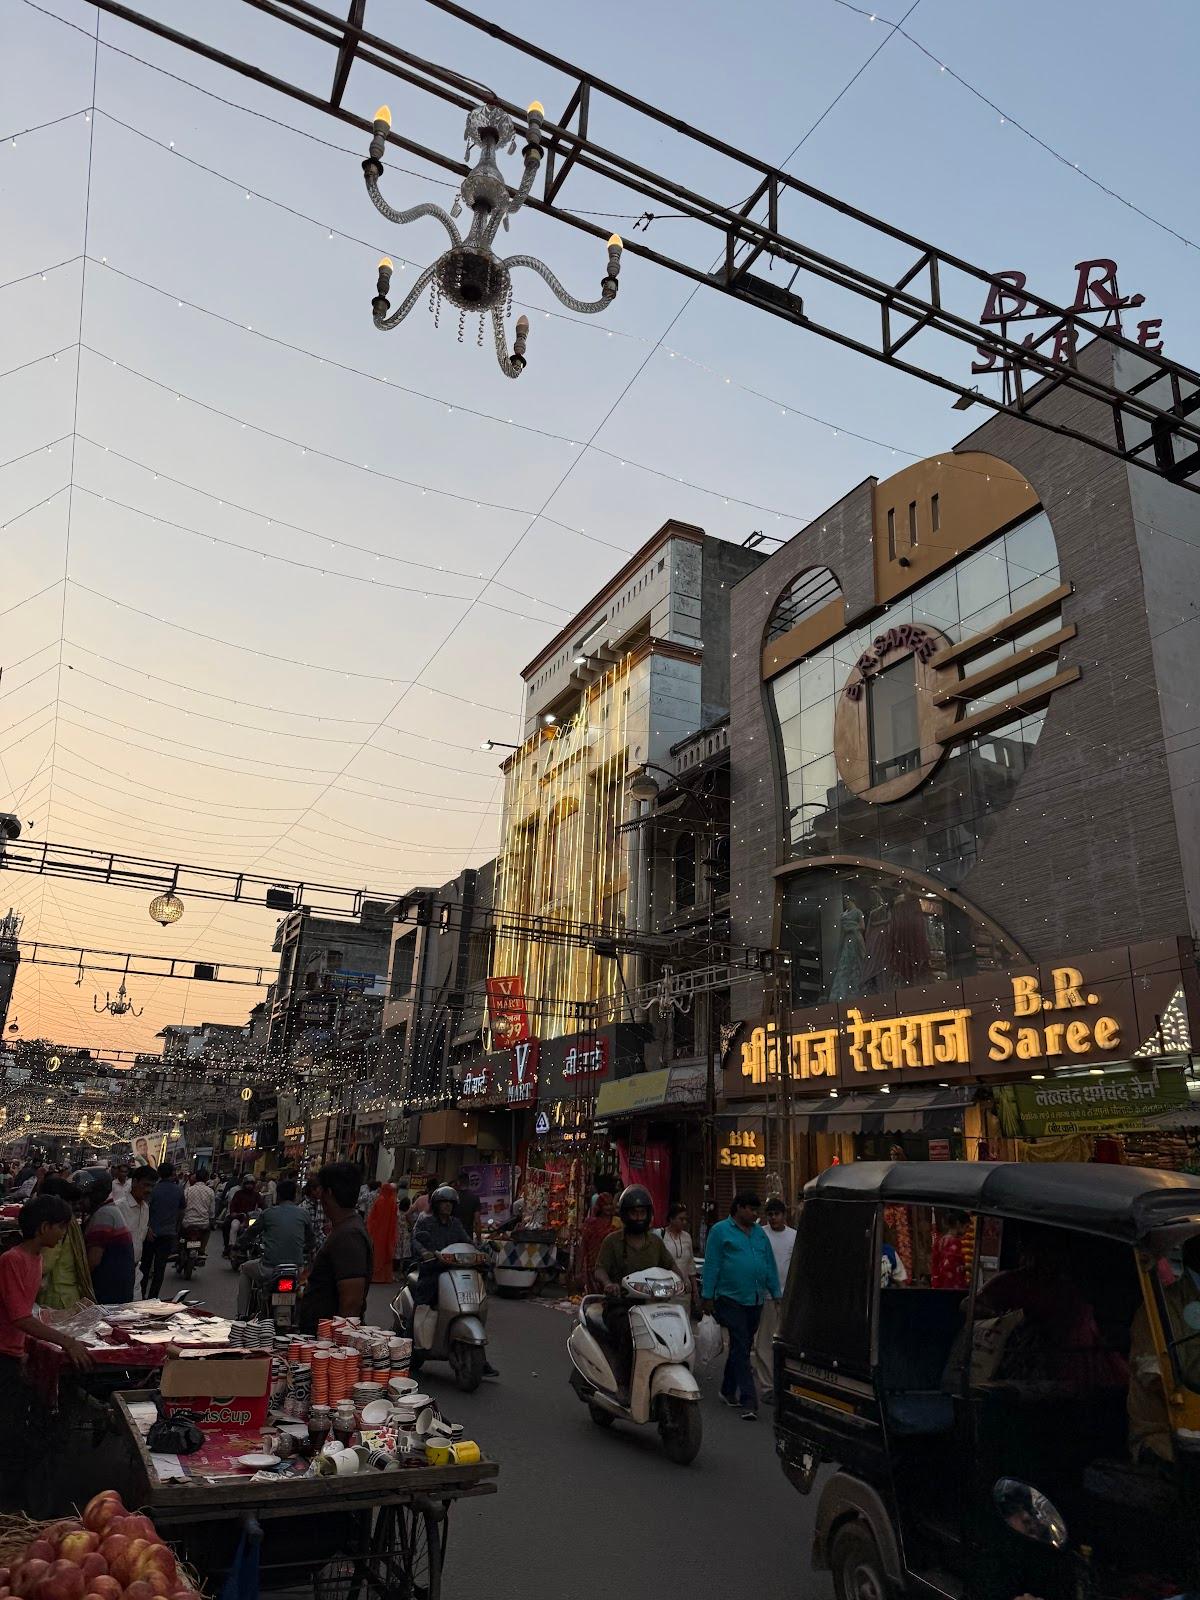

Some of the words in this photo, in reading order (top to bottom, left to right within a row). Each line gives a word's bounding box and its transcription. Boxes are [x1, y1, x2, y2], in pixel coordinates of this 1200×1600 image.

[498, 981, 514, 998] V
[1011, 966, 1099, 1017] B.R.
[496, 999, 521, 1009] MART
[846, 1008, 972, 1073] रेखराज
[988, 1015, 1121, 1062] Saree
[515, 1042, 533, 1083] V
[507, 1082, 532, 1103] MART
[1129, 1076, 1156, 1100] जैन
[728, 1129, 757, 1149] BR
[720, 1147, 766, 1168] Saree
